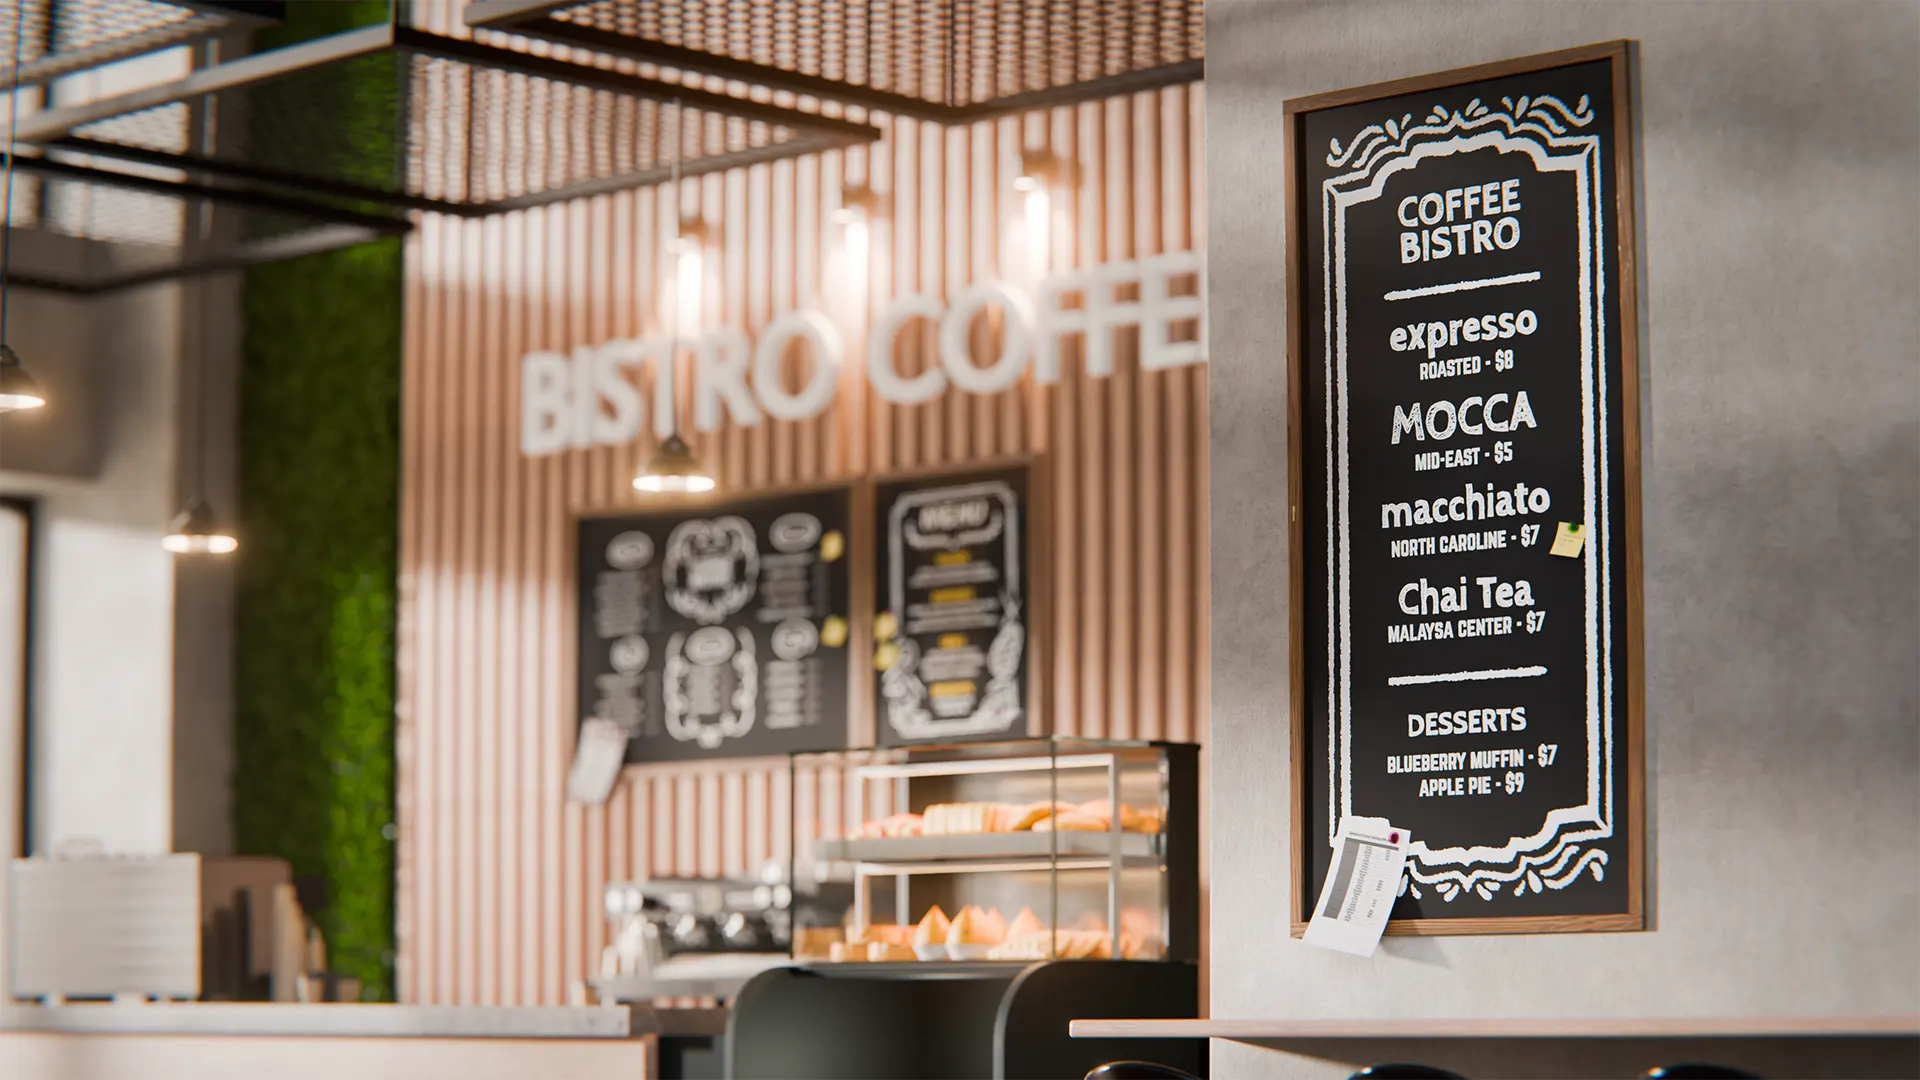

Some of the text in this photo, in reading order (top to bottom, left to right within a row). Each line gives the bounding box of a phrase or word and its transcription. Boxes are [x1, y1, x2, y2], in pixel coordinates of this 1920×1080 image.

[1397, 178, 1522, 228] COFFEE
[1400, 216, 1521, 264] BISTRO
[1389, 309, 1539, 360] expresso
[521, 309, 844, 458] BISTRO
[1419, 355, 1482, 381] ROASTED
[1494, 348, 1514, 373] $8
[1390, 390, 1538, 445] MOCCA
[1414, 446, 1481, 472] MID-EAST
[1494, 440, 1514, 465] $5
[1381, 482, 1551, 529] macchiato
[1390, 536, 1436, 559] NORTH
[1439, 529, 1507, 554] CAROLINE
[1520, 523, 1541, 548] $7
[1398, 575, 1536, 616] Chai Tea
[1387, 620, 1455, 644] MALAYSA
[1457, 615, 1513, 638] CENTER
[1525, 609, 1546, 635] $7
[1407, 706, 1527, 739] DESSERTS
[1386, 751, 1467, 774] BLUEBERRY
[1469, 748, 1525, 770] MUFFIN
[1537, 743, 1558, 768] $7
[1418, 776, 1465, 798] APPLE
[1467, 775, 1492, 795] PIE
[1504, 770, 1525, 795] $9
